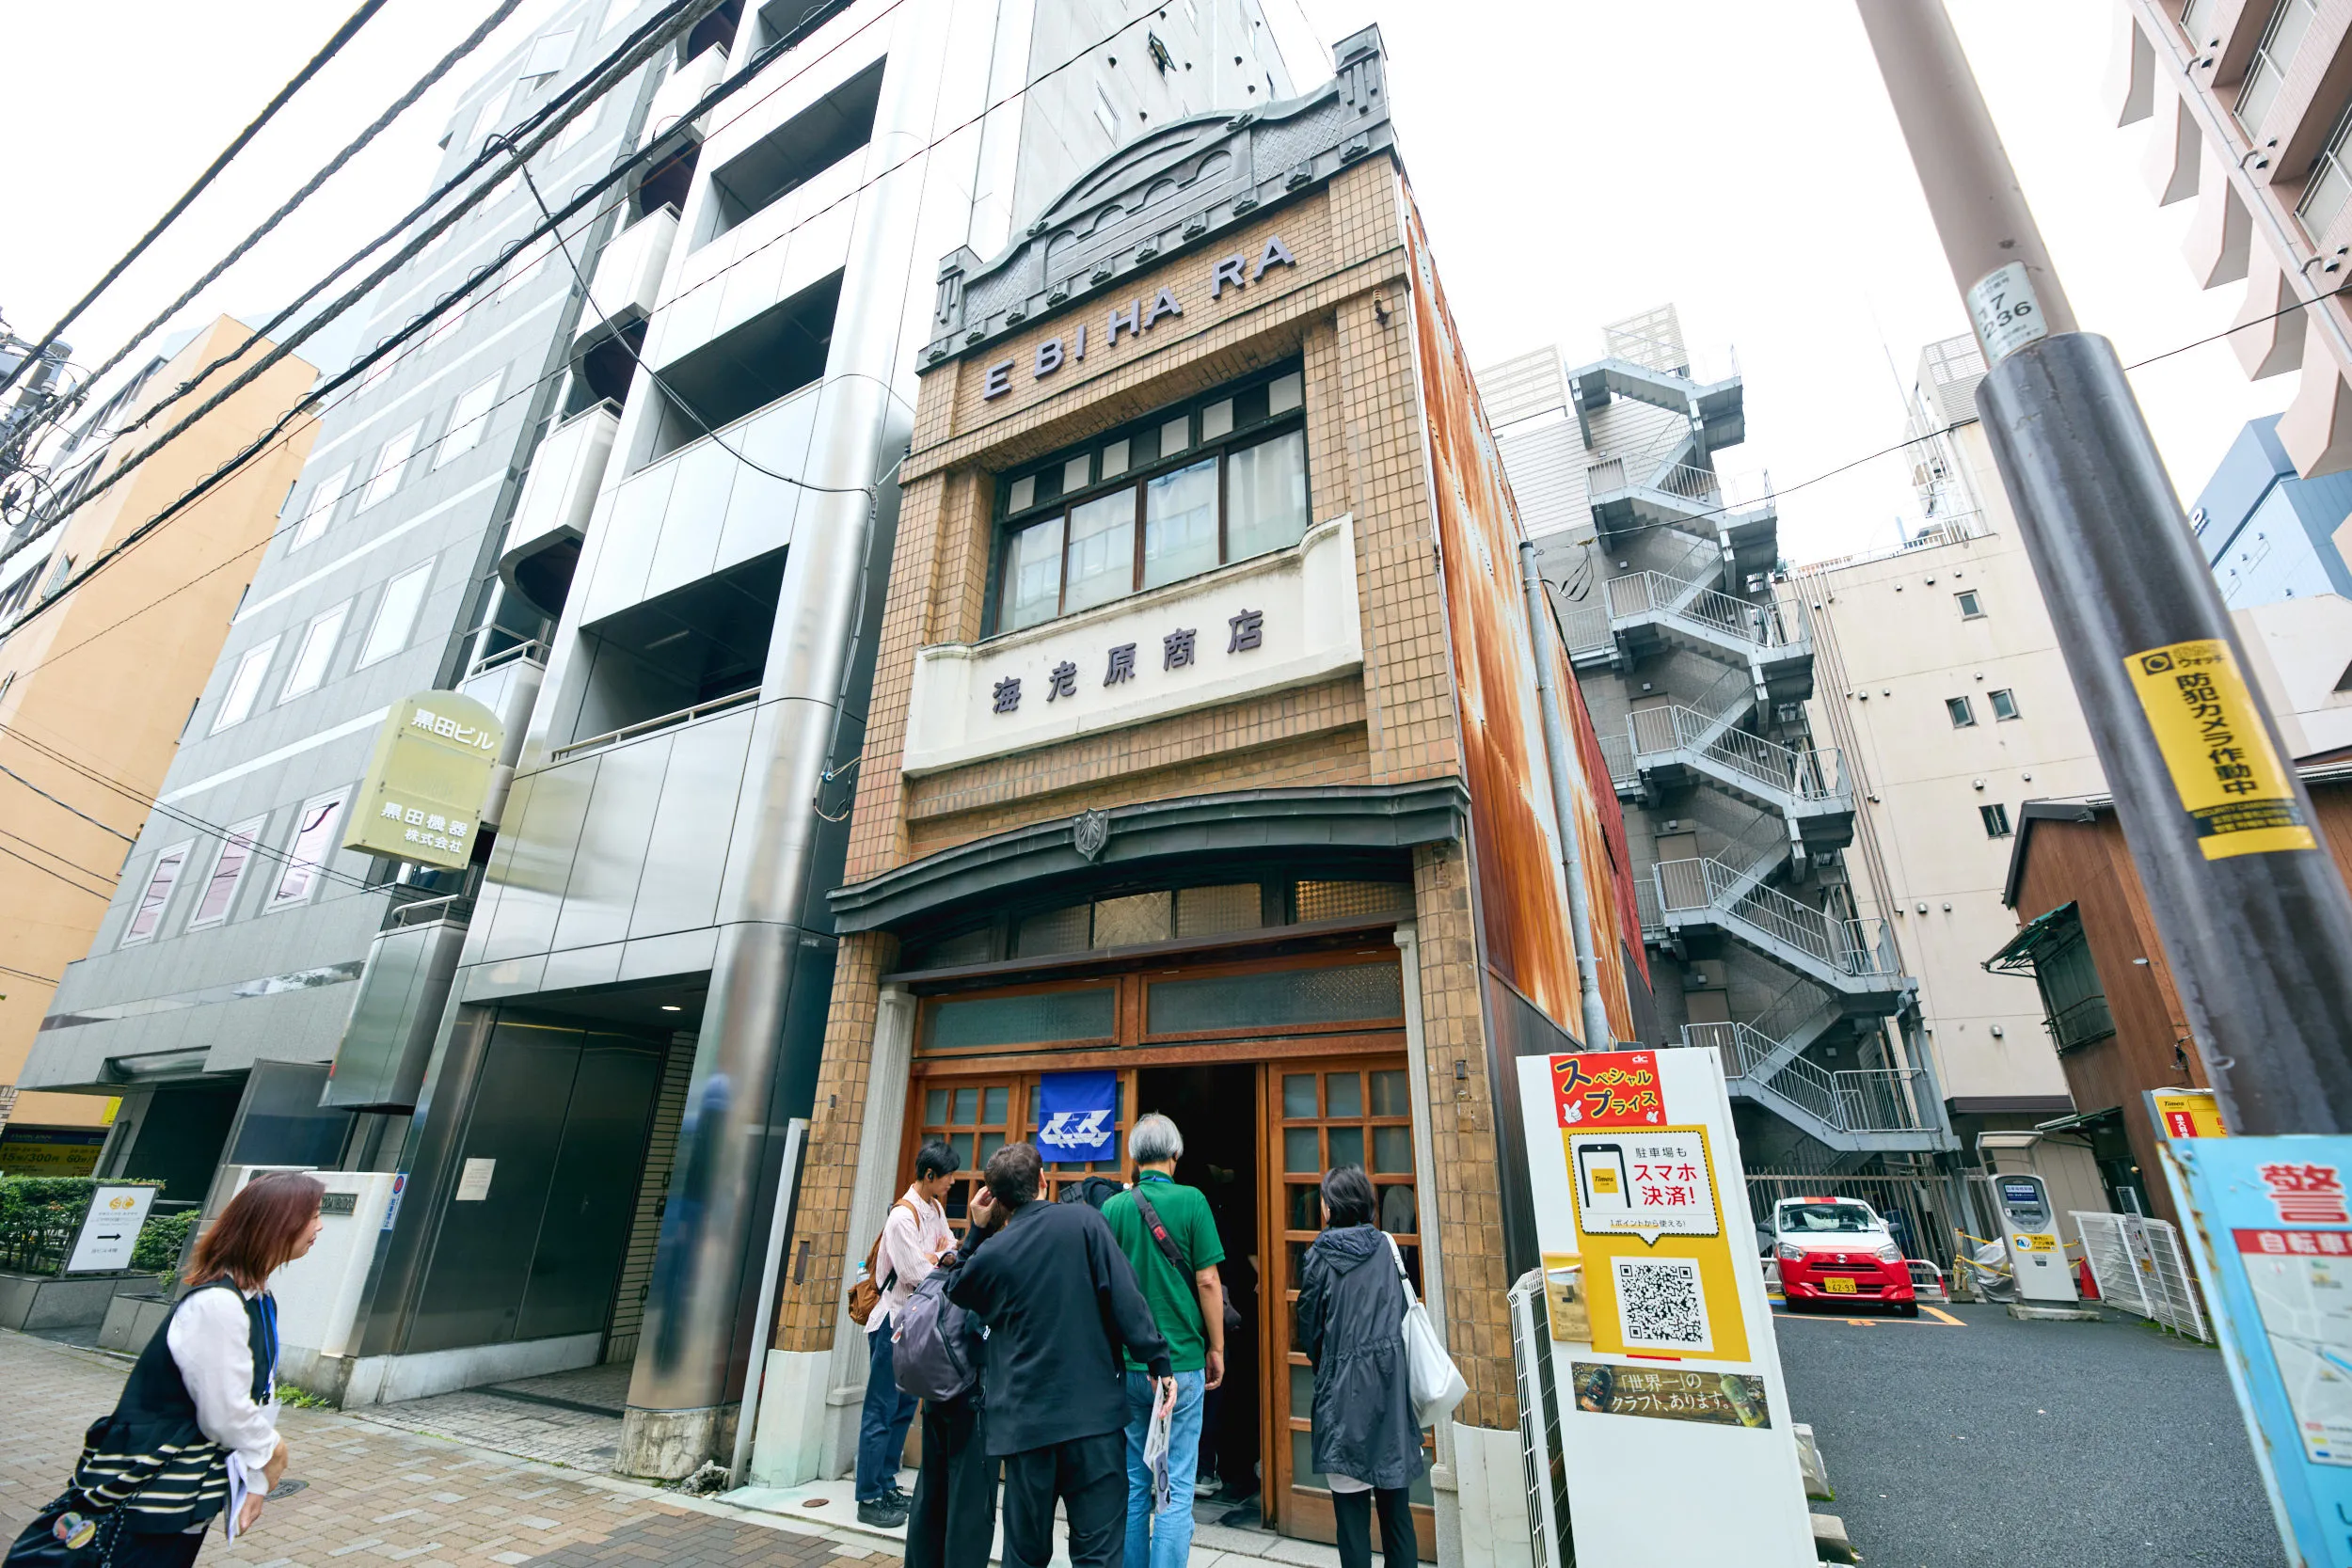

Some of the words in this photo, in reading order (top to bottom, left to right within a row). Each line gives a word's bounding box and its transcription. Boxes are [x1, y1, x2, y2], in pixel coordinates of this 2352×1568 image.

[992, 608, 1264, 716] 海老原商店
[409, 707, 496, 751] 黒田ビル
[2175, 672, 2259, 796] 防犯カメラ作動中
[380, 800, 469, 838] 黒田機器
[404, 827, 463, 855] 株式会社
[1555, 1059, 1653, 1093] スペシャル
[1585, 1089, 1658, 1117] プライス
[1635, 1147, 1688, 1159] 駐車場も
[1594, 1175, 1614, 1183] Times
[1633, 1163, 1697, 1181] スマホ
[1642, 1185, 1696, 1206] 決済!
[2260, 1164, 2350, 1224] 警
[2258, 1232, 2352, 1254] 自転車
[1832, 1284, 1855, 1292] 62-93
[1612, 1390, 1729, 1413] クラフト、あります。
